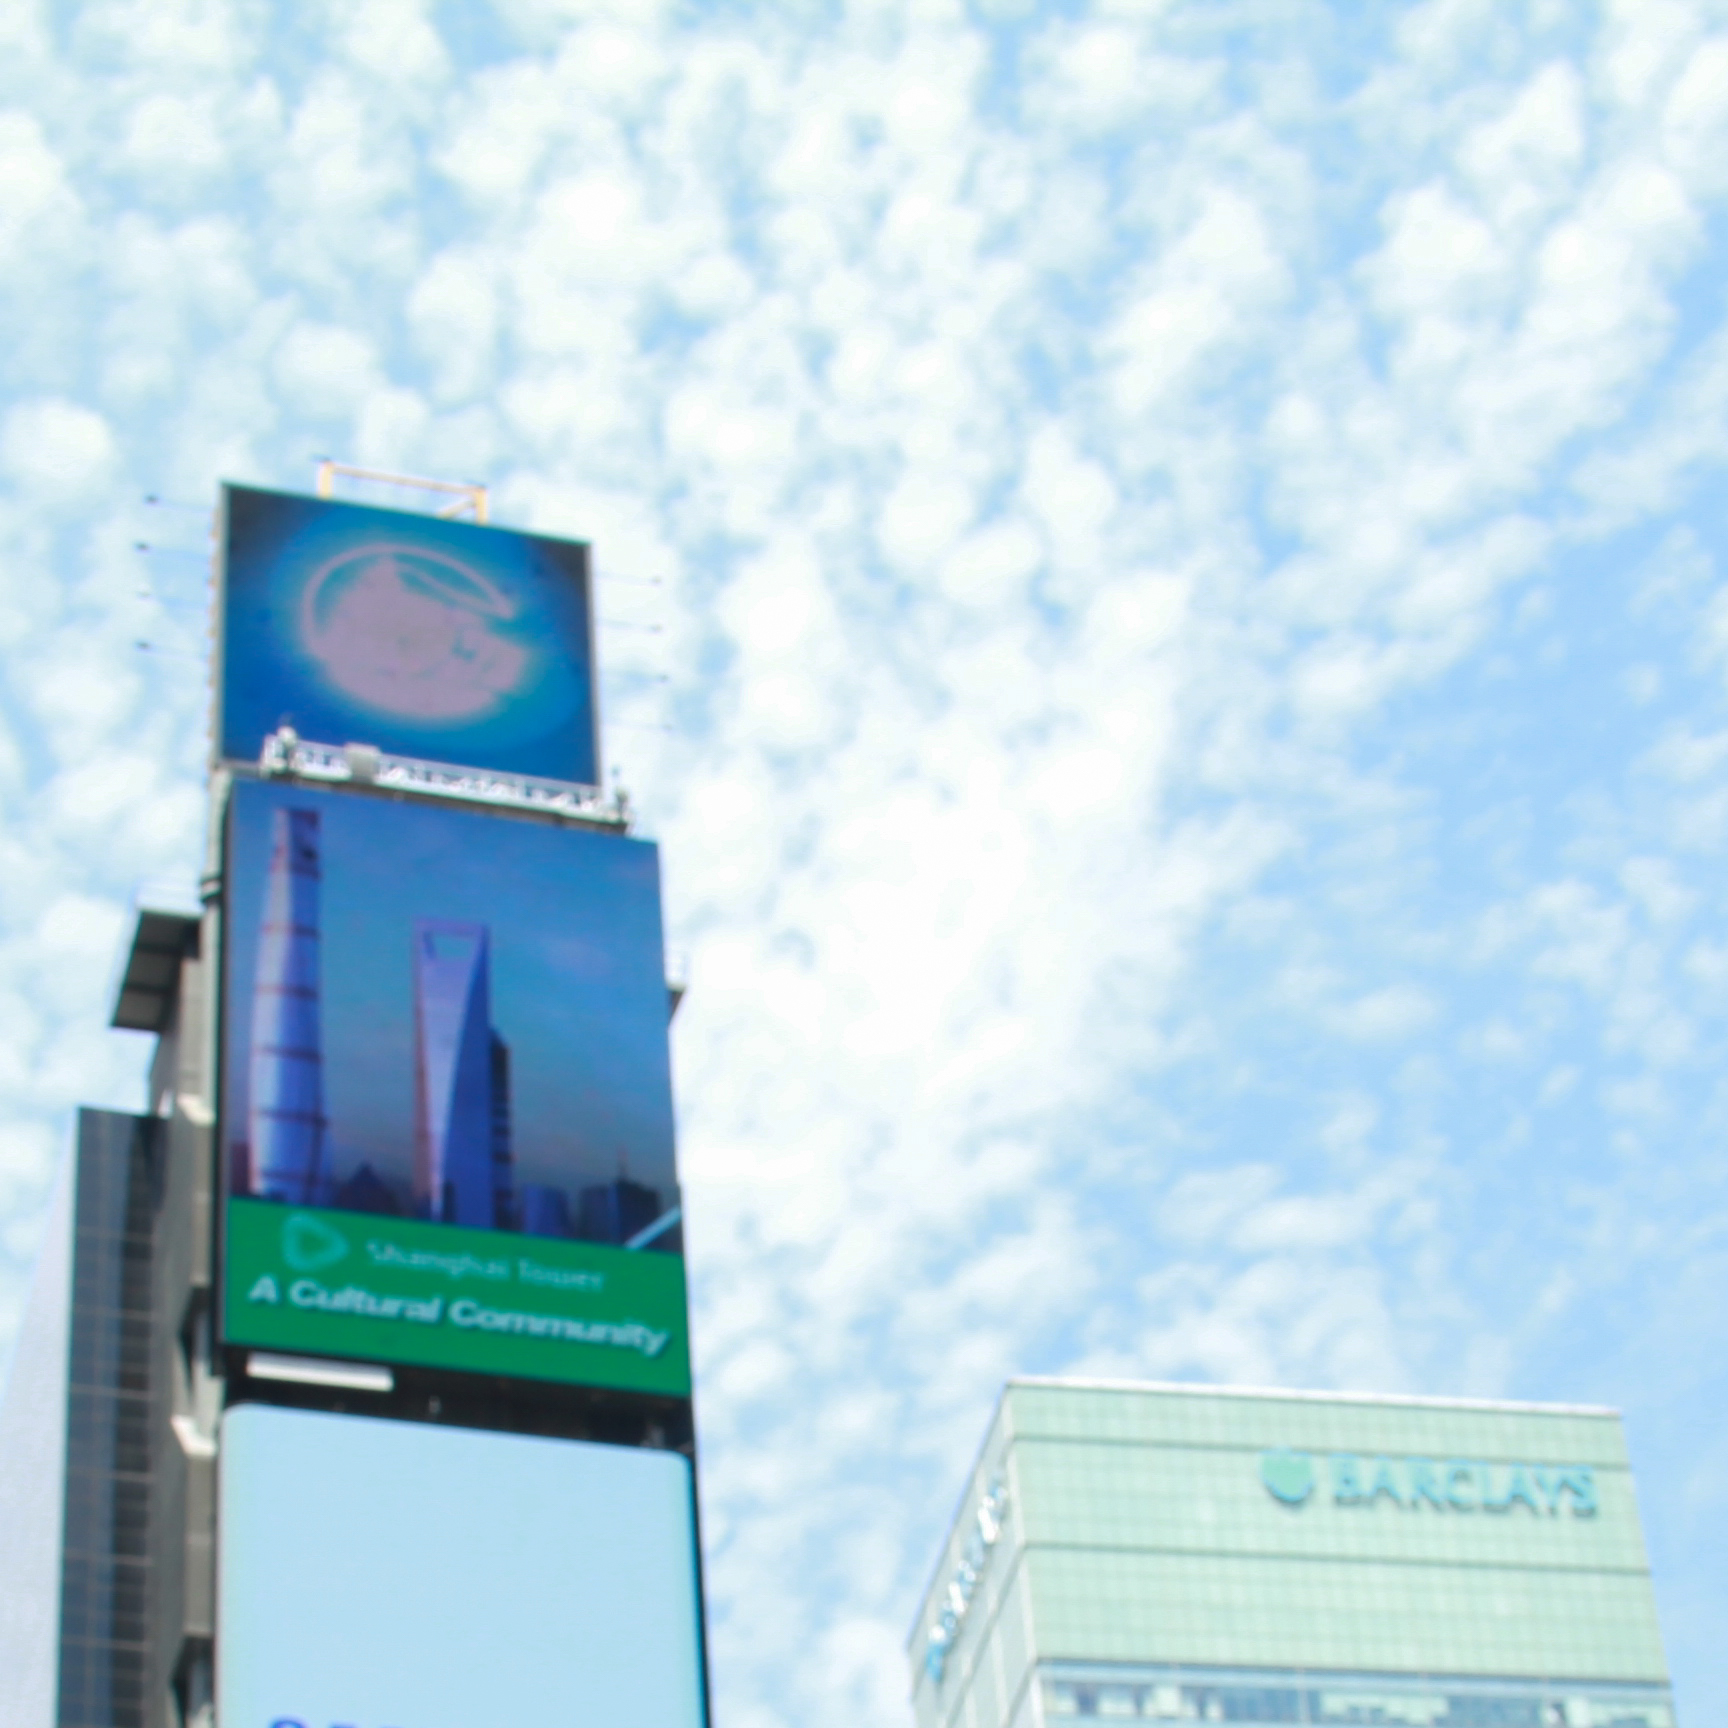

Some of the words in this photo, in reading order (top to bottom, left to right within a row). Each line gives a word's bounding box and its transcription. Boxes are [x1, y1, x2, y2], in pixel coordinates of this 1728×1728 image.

[368, 1239, 511, 1281] Shanghai
[518, 1258, 606, 1294] Tower
[248, 1274, 279, 1305] A
[288, 1278, 444, 1324] Cultural
[448, 1299, 672, 1359] Community
[1330, 1453, 1598, 1517] BARCLAYS
